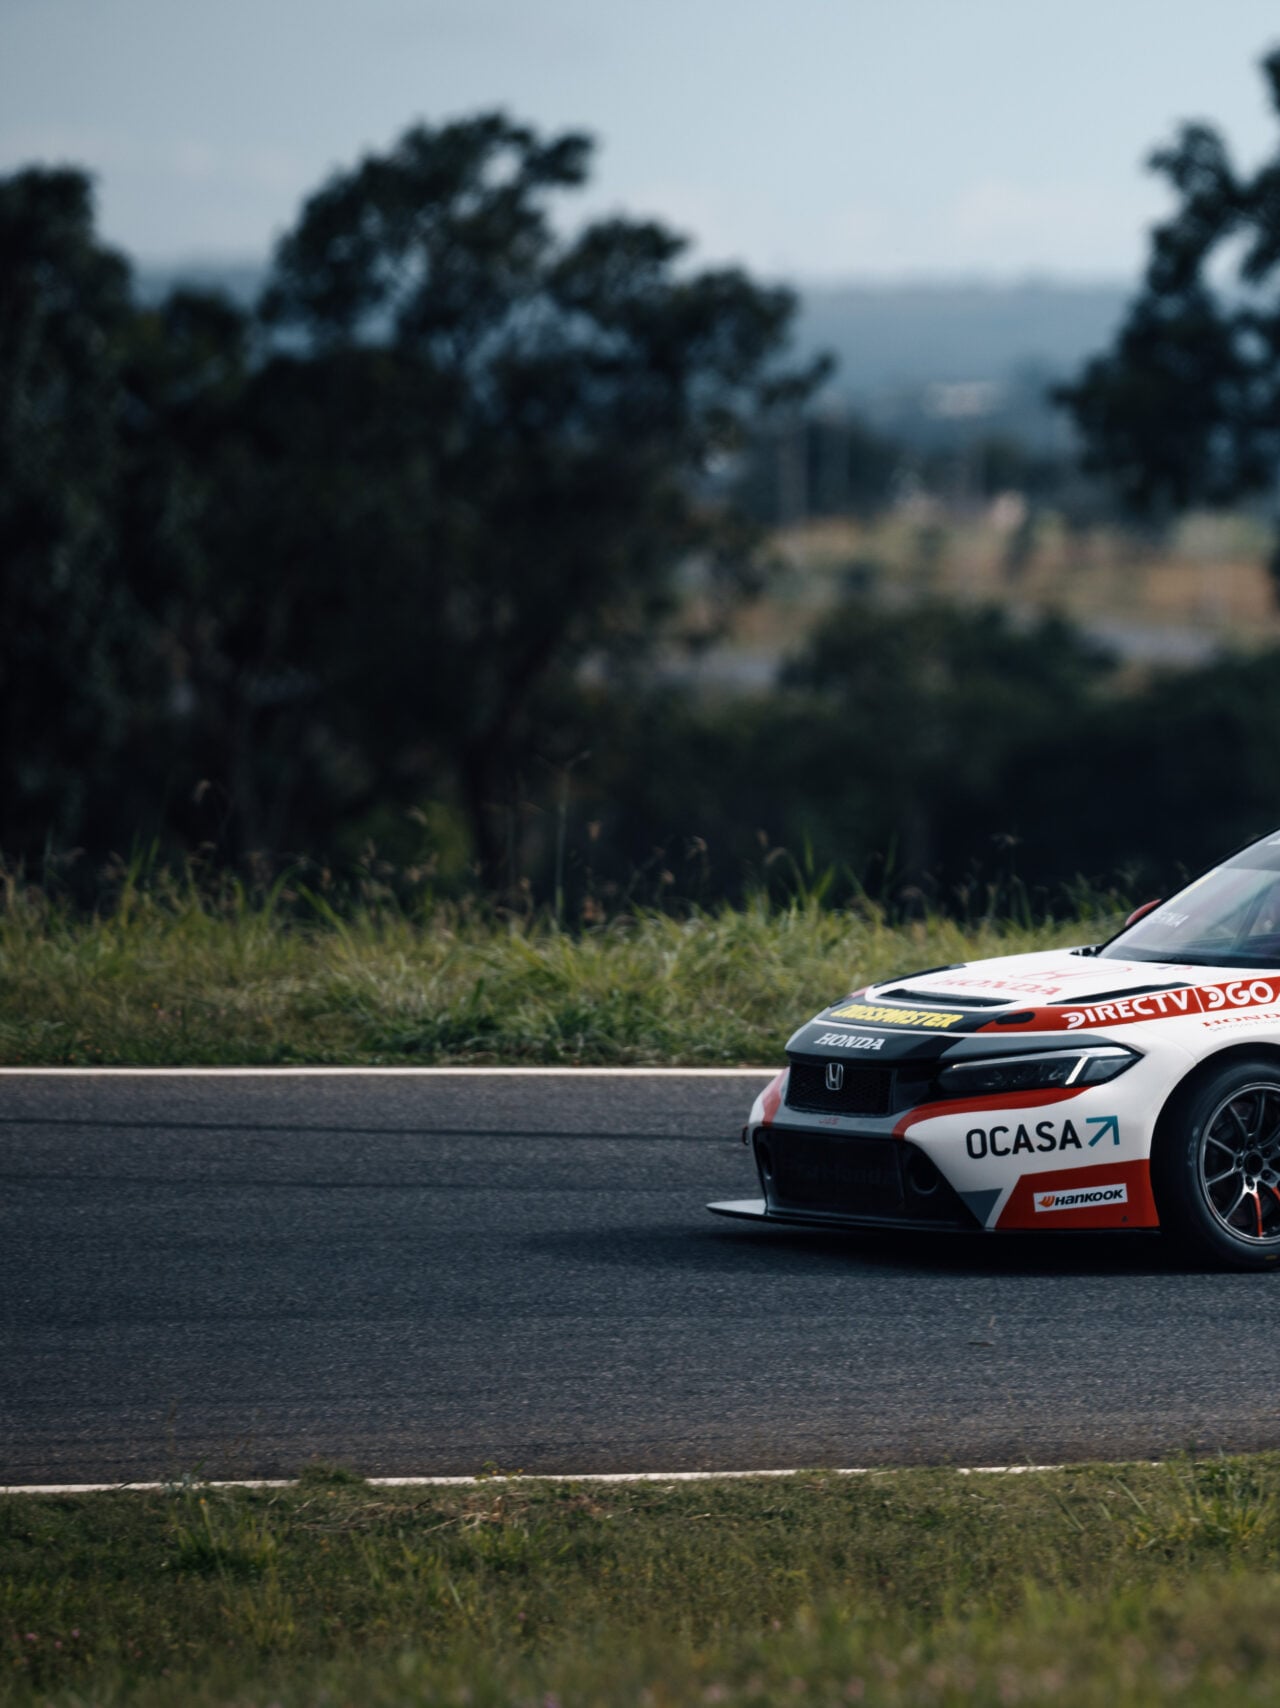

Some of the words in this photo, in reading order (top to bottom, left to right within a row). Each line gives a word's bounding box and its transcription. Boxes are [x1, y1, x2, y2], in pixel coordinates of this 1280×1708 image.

[1060, 988, 1189, 1030] DIRECTV
[813, 1032, 886, 1051] HONDA
[966, 1119, 1082, 1160] OCASA
